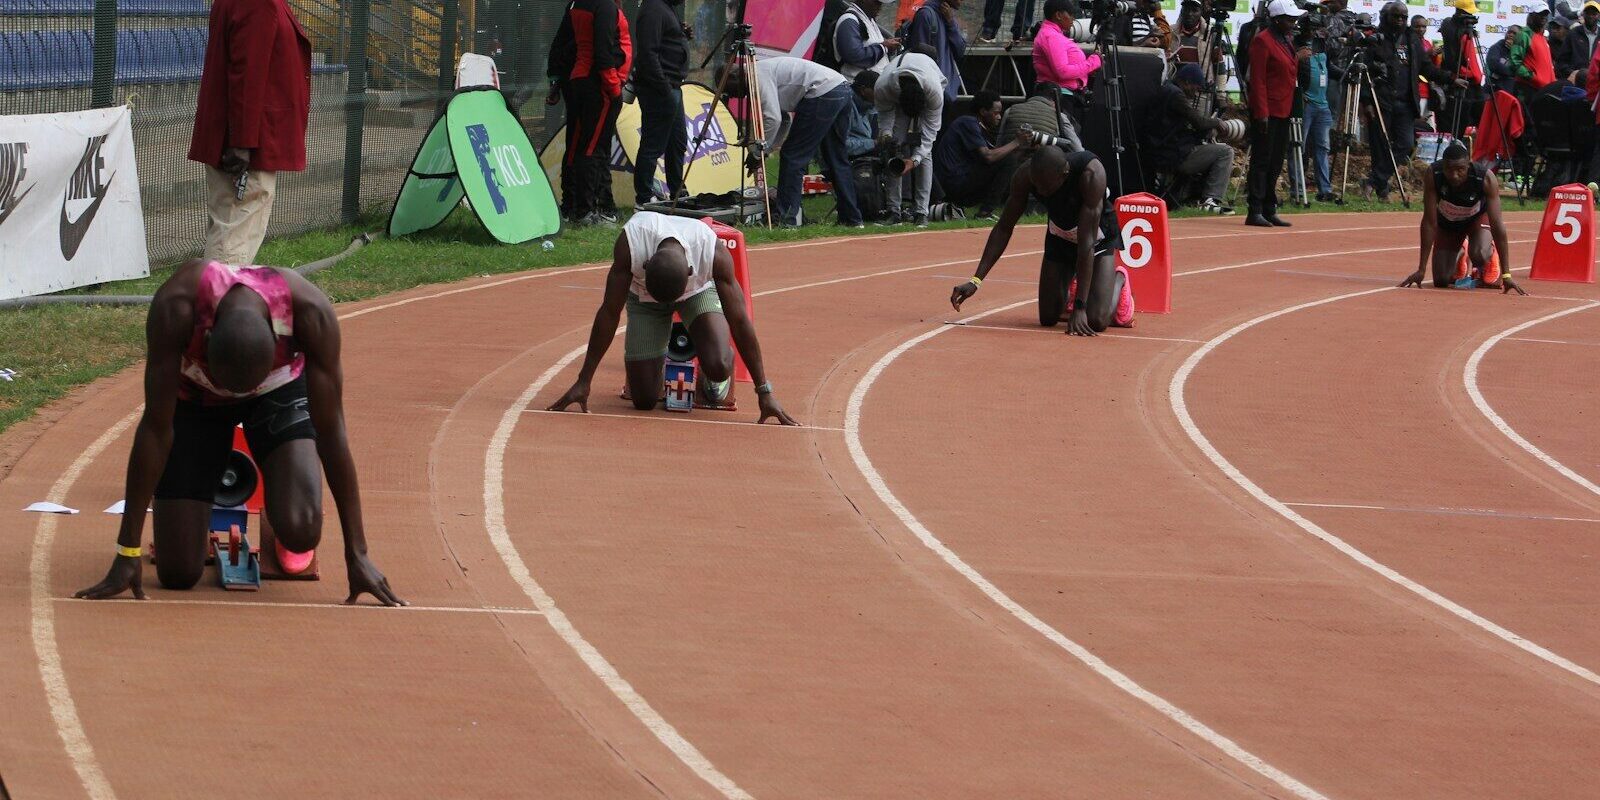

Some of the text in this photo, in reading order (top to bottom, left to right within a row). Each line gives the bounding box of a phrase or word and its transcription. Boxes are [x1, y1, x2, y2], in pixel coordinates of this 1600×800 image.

[0, 142, 29, 209] IKE
[493, 144, 531, 187] KCB
[1119, 203, 1160, 214] MONDO
[1555, 192, 1587, 201] MONDO
[1119, 218, 1154, 268] 6
[1552, 203, 1582, 245] 5
